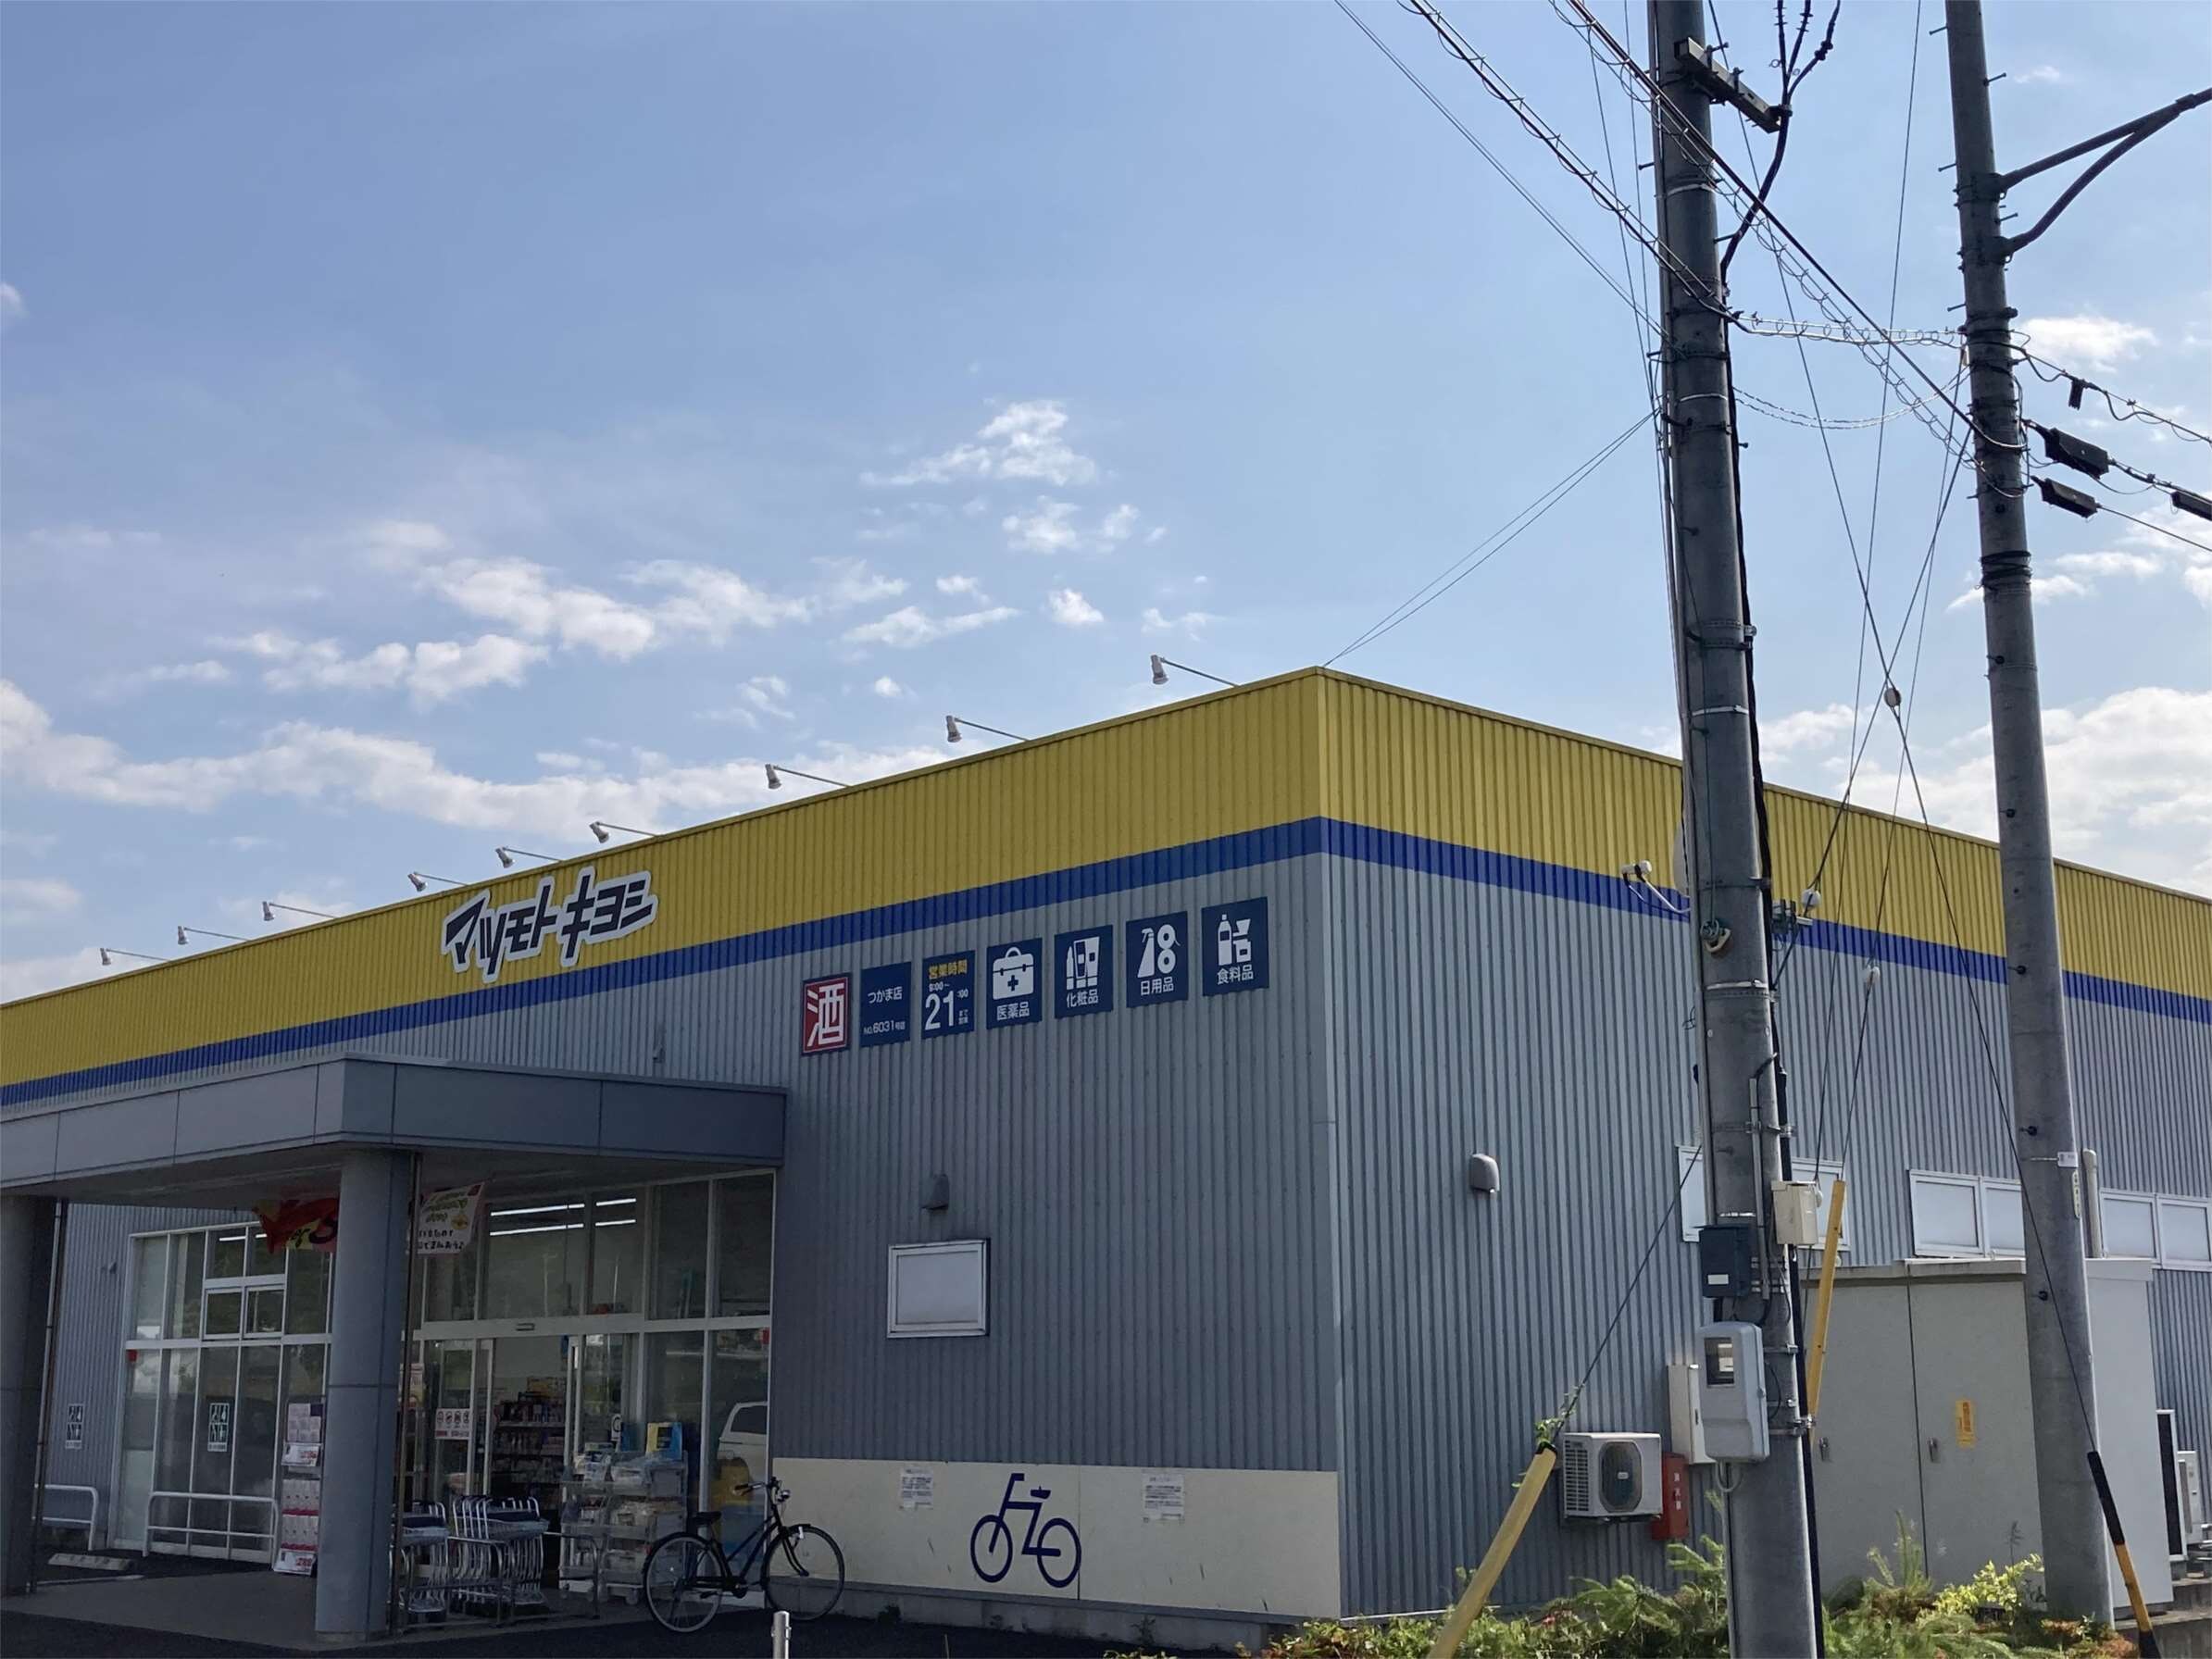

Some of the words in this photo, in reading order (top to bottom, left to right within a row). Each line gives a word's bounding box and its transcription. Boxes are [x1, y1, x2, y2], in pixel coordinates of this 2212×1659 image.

[444, 872, 655, 977] マツモトキヨシ
[1217, 964, 1255, 985] 食料品
[868, 986, 903, 1004] つかま店
[1140, 976, 1175, 996] 日用品
[1066, 989, 1099, 1008] 化粧品
[807, 983, 844, 1046] 酒
[996, 1001, 1031, 1021] 医薬品
